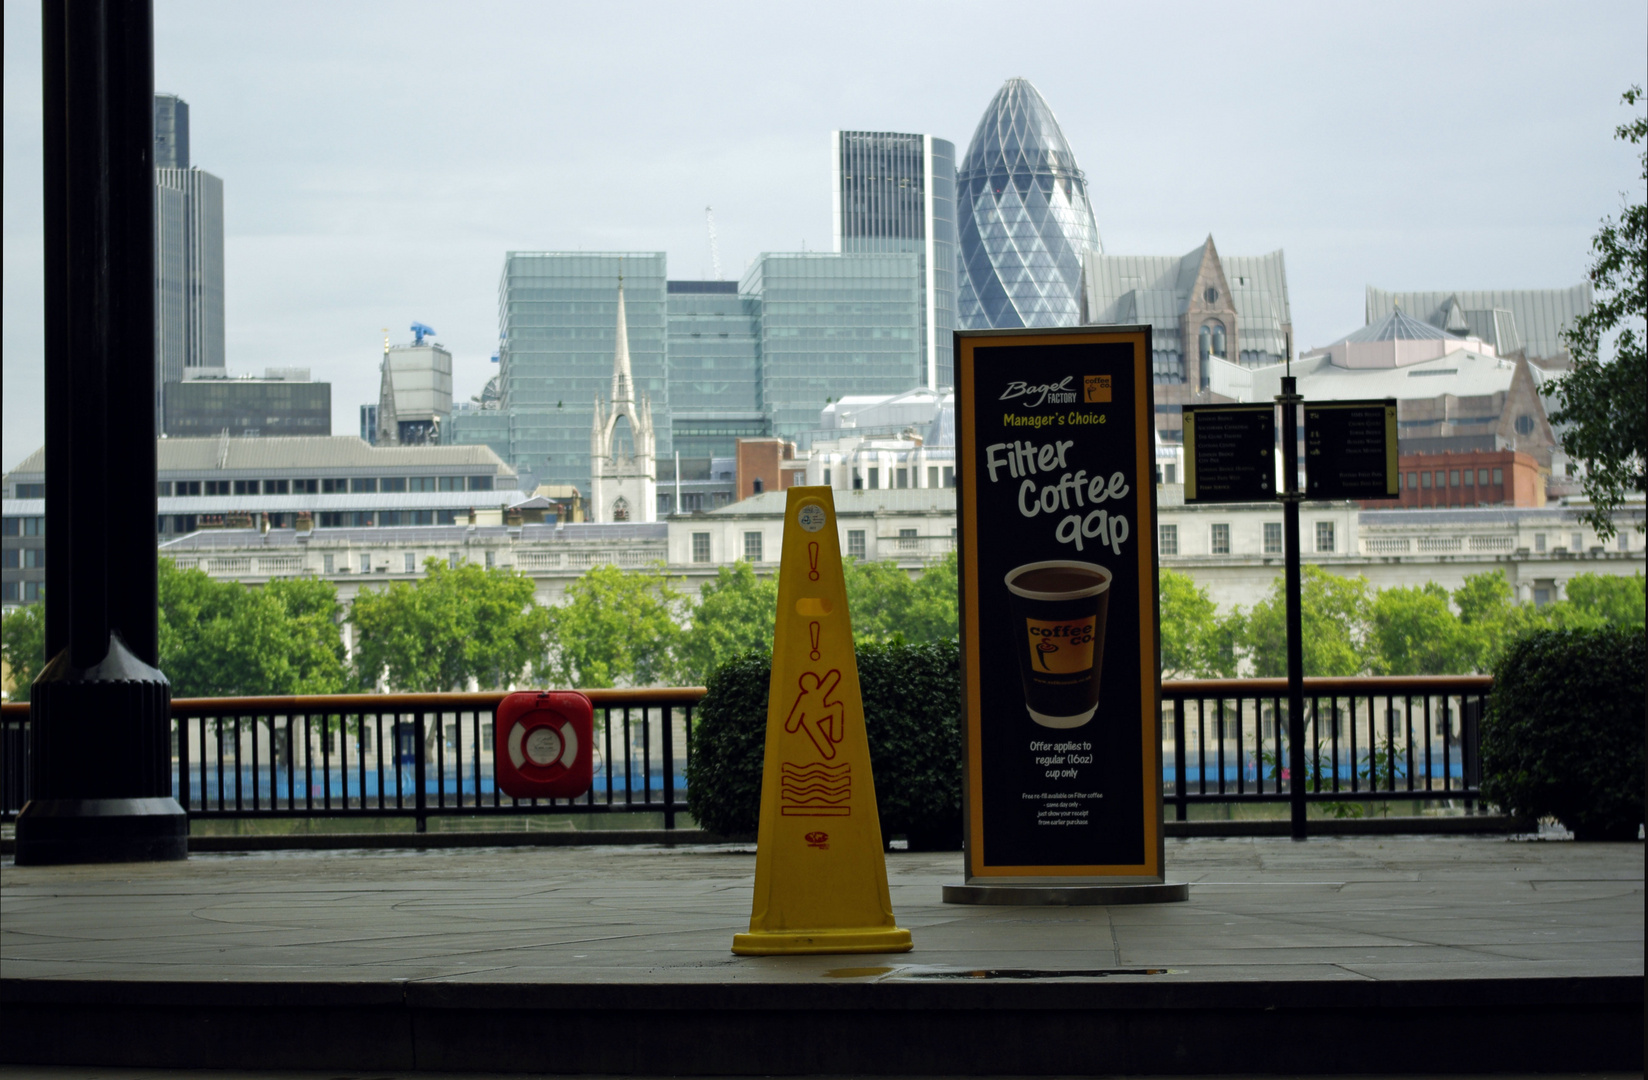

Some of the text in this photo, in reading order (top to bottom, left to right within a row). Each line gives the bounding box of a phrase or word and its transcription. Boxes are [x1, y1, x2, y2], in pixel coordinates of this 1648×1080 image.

[1085, 377, 1110, 385] coffee
[998, 375, 1078, 408] Bagel
[1047, 392, 1077, 404] FACTORY
[1003, 411, 1107, 429] Manager's Choice
[985, 439, 1075, 483] Filter
[1017, 469, 1131, 518] Coffee
[1030, 624, 1093, 638] coffee
[1070, 634, 1096, 646] co.
[1029, 740, 1092, 754] Offer applies to
[1035, 753, 1094, 767] regular (16oz)
[1045, 767, 1079, 781] cup only
[1021, 792, 1033, 800] Free
[1074, 791, 1087, 799] Filter
[1087, 791, 1104, 799] coffee
[1059, 801, 1068, 809] day
[1068, 801, 1079, 809] only
[1036, 810, 1047, 818] just
[1071, 810, 1089, 818] receipt
[1050, 818, 1066, 826] earlier
[1066, 818, 1089, 827] purchase
